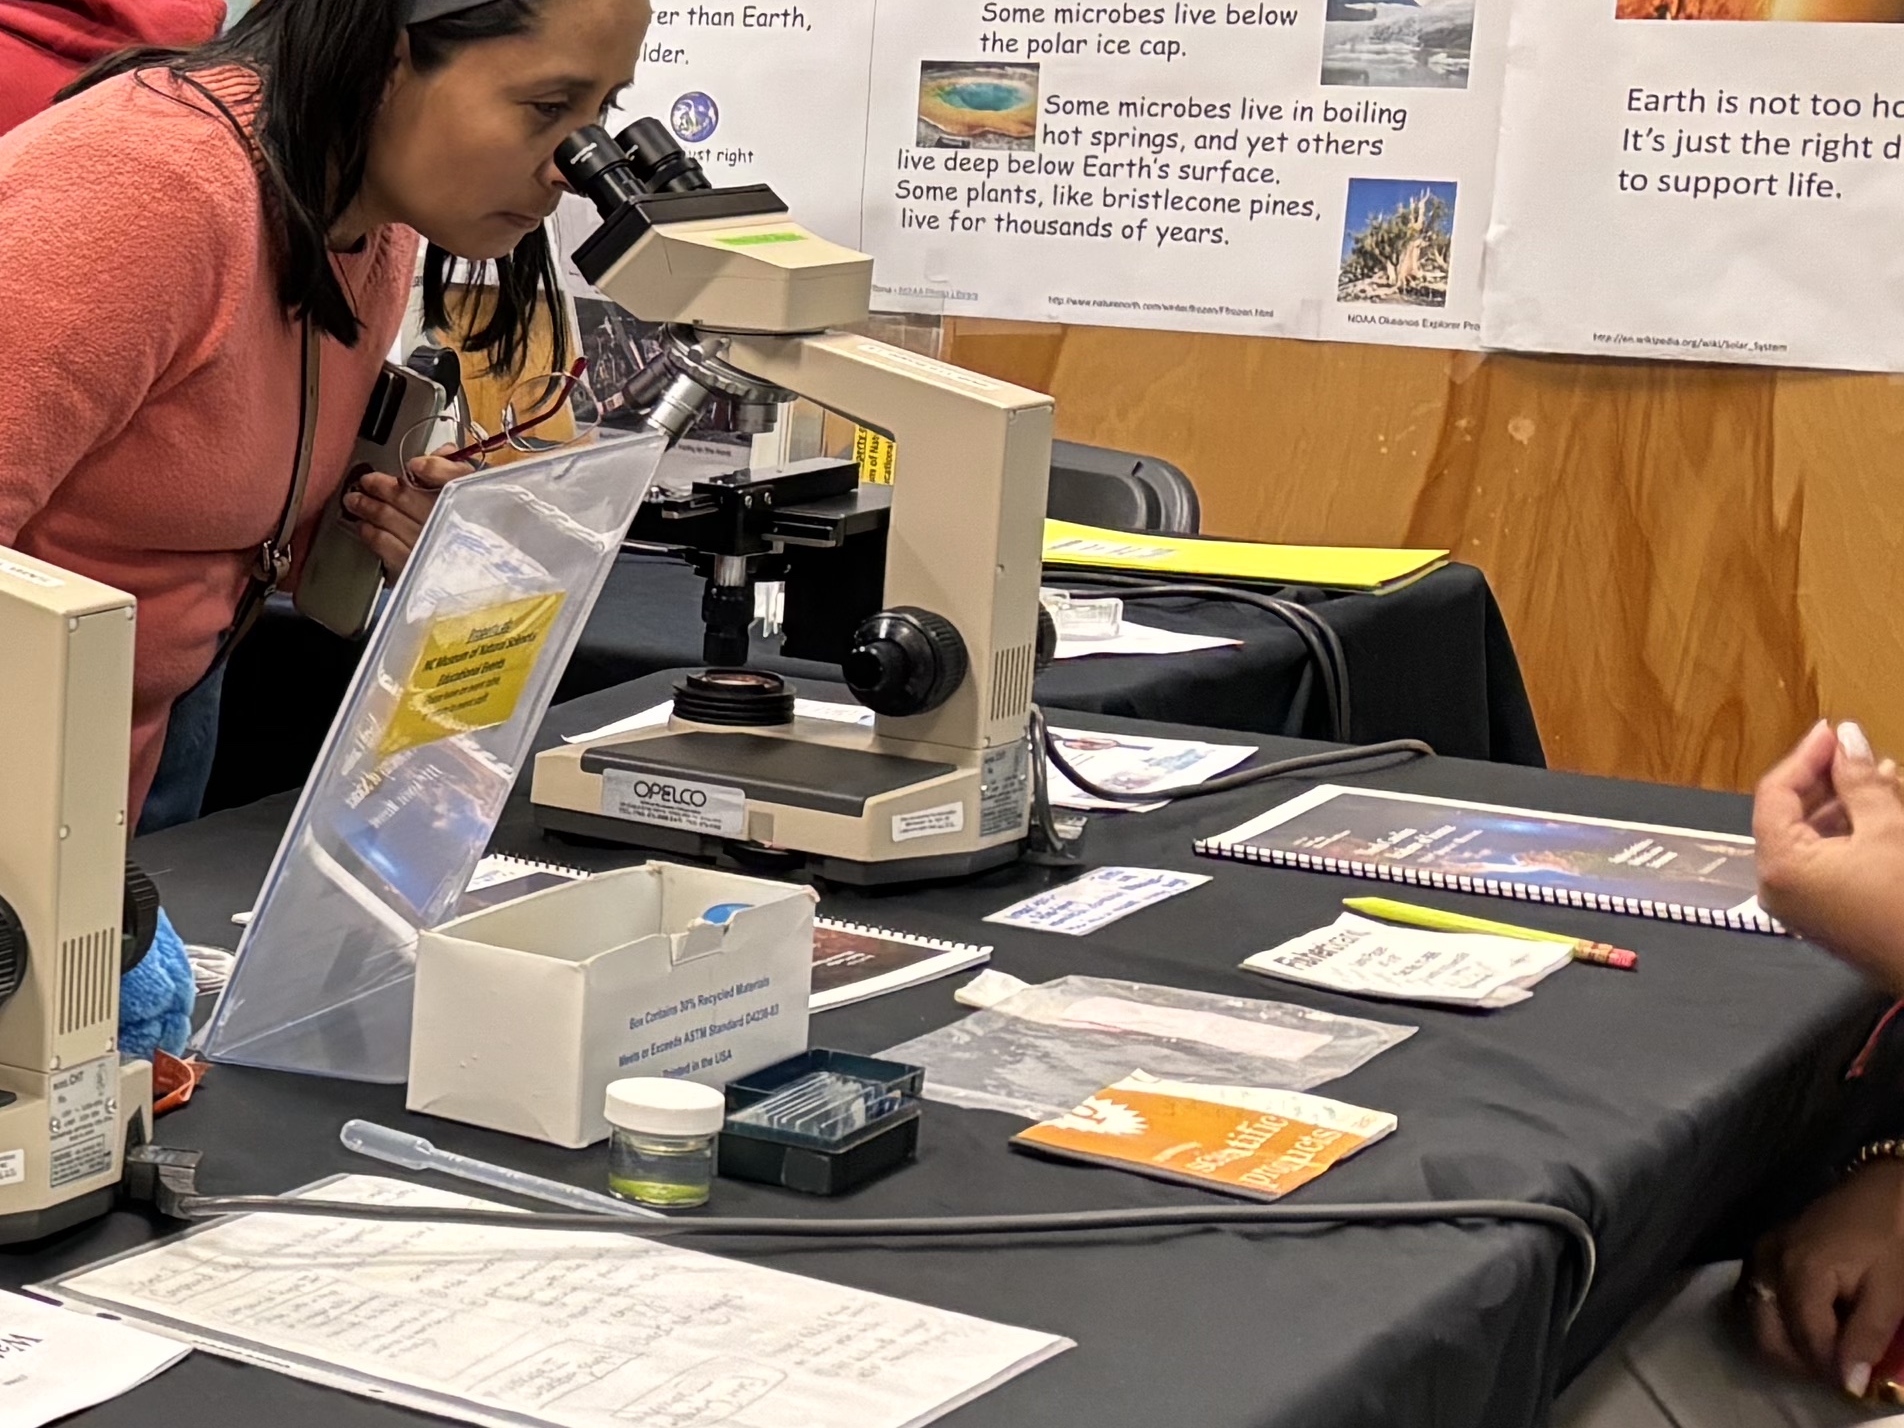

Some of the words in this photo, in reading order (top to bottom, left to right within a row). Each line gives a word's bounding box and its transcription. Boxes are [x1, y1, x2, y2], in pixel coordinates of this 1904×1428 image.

[686, 4, 735, 28] than
[742, 5, 813, 32] Earth,
[981, 1, 1046, 24] Some
[1054, 1, 1166, 25] microbes
[1174, 1, 1217, 25] live
[1225, 1, 1299, 27] below
[979, 30, 1019, 53] the
[1026, 31, 1088, 60] polar
[1096, 32, 1131, 55] ice
[1139, 39, 1187, 63] cap.
[1043, 94, 1110, 117] Some
[1118, 95, 1232, 120] microbes
[1240, 96, 1284, 121] live
[1292, 99, 1314, 123] in
[1323, 99, 1408, 132] boiling
[1627, 87, 1706, 114] Earth
[1716, 89, 1739, 114] is
[1749, 93, 1801, 116] not
[1810, 93, 1862, 118] too
[716, 148, 755, 167] right
[1042, 125, 1083, 149] hot
[1090, 125, 1186, 155] springs,
[1193, 127, 1239, 151] and
[1246, 131, 1289, 159] yet
[1296, 131, 1384, 157] others
[1622, 126, 1665, 153] It’s
[1671, 128, 1732, 159] just
[1740, 129, 1791, 156] the
[1801, 132, 1874, 163] right
[897, 147, 936, 171] live
[943, 150, 999, 180] deep
[1007, 152, 1075, 177] below
[1082, 154, 1171, 180] Earth's
[1177, 159, 1281, 185] surface.
[894, 179, 958, 202] Some
[966, 180, 1044, 209] plants,
[1052, 183, 1094, 207] like
[1102, 186, 1241, 214] bristlecone
[1249, 193, 1321, 222] pines,
[1618, 169, 1648, 192] to
[1656, 173, 1779, 200] support
[1787, 171, 1842, 200] life.
[901, 207, 940, 230] live
[948, 208, 987, 233] for
[993, 211, 1113, 239] thousands
[1121, 217, 1149, 242] of
[1155, 225, 1230, 248] years.
[633, 780, 708, 808] OPELCO
